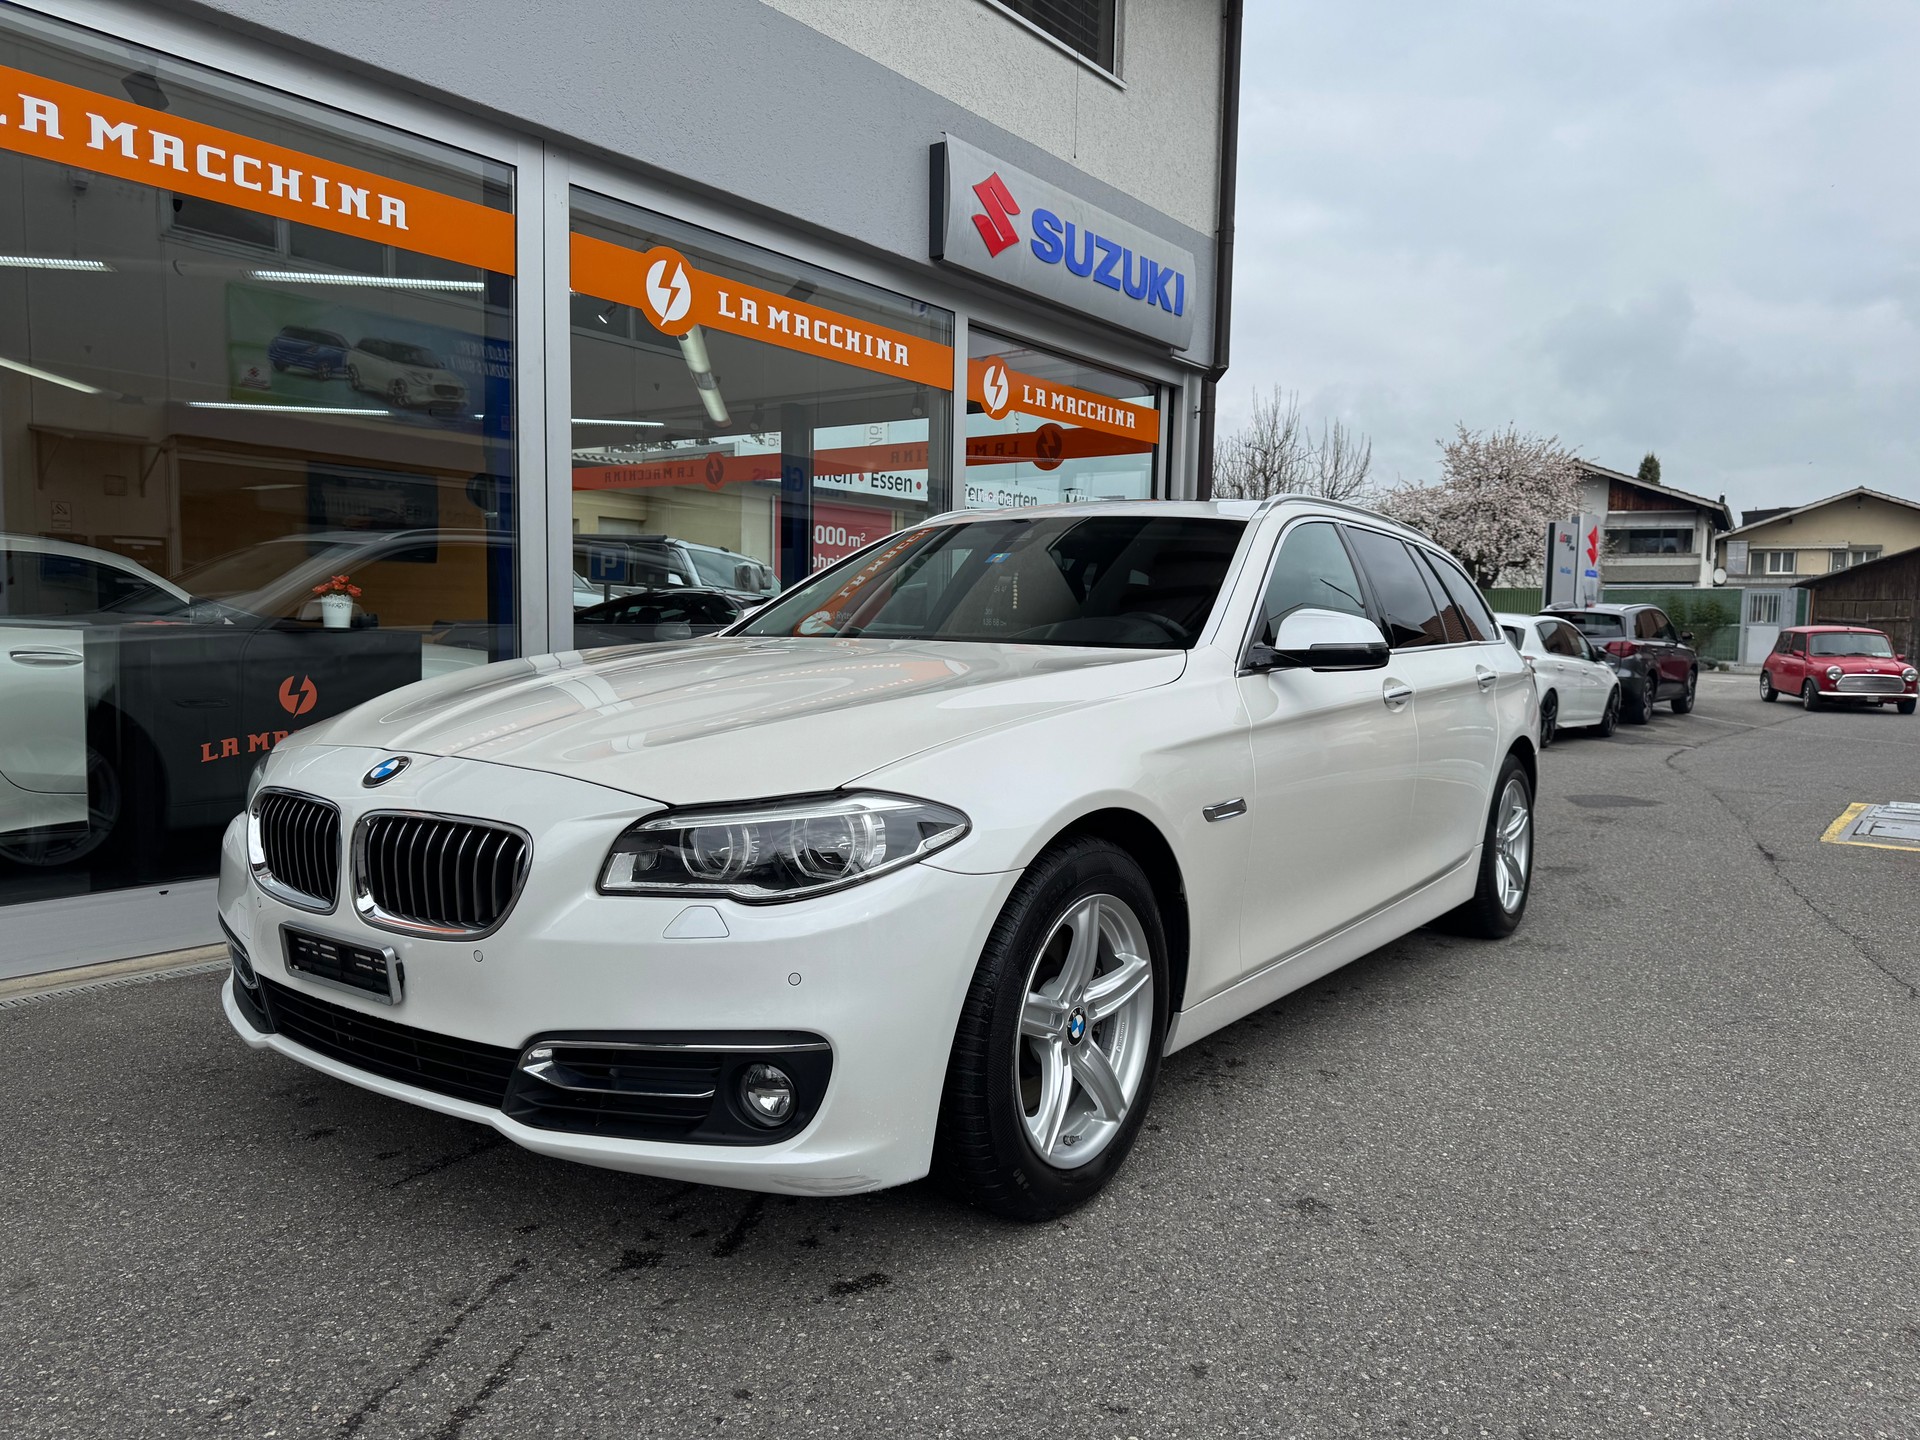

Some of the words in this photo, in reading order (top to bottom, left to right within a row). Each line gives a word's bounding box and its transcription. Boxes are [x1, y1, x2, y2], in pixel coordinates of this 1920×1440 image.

[0, 93, 65, 140] A
[85, 112, 409, 231] MACCHINA
[1030, 208, 1185, 318] SUZUKI
[718, 290, 760, 325] LA
[767, 305, 909, 367] MACCHINA
[1022, 384, 1047, 408] LA
[1050, 391, 1136, 429] MACCHINA
[870, 471, 913, 493] Essen
[200, 737, 240, 763] LA
